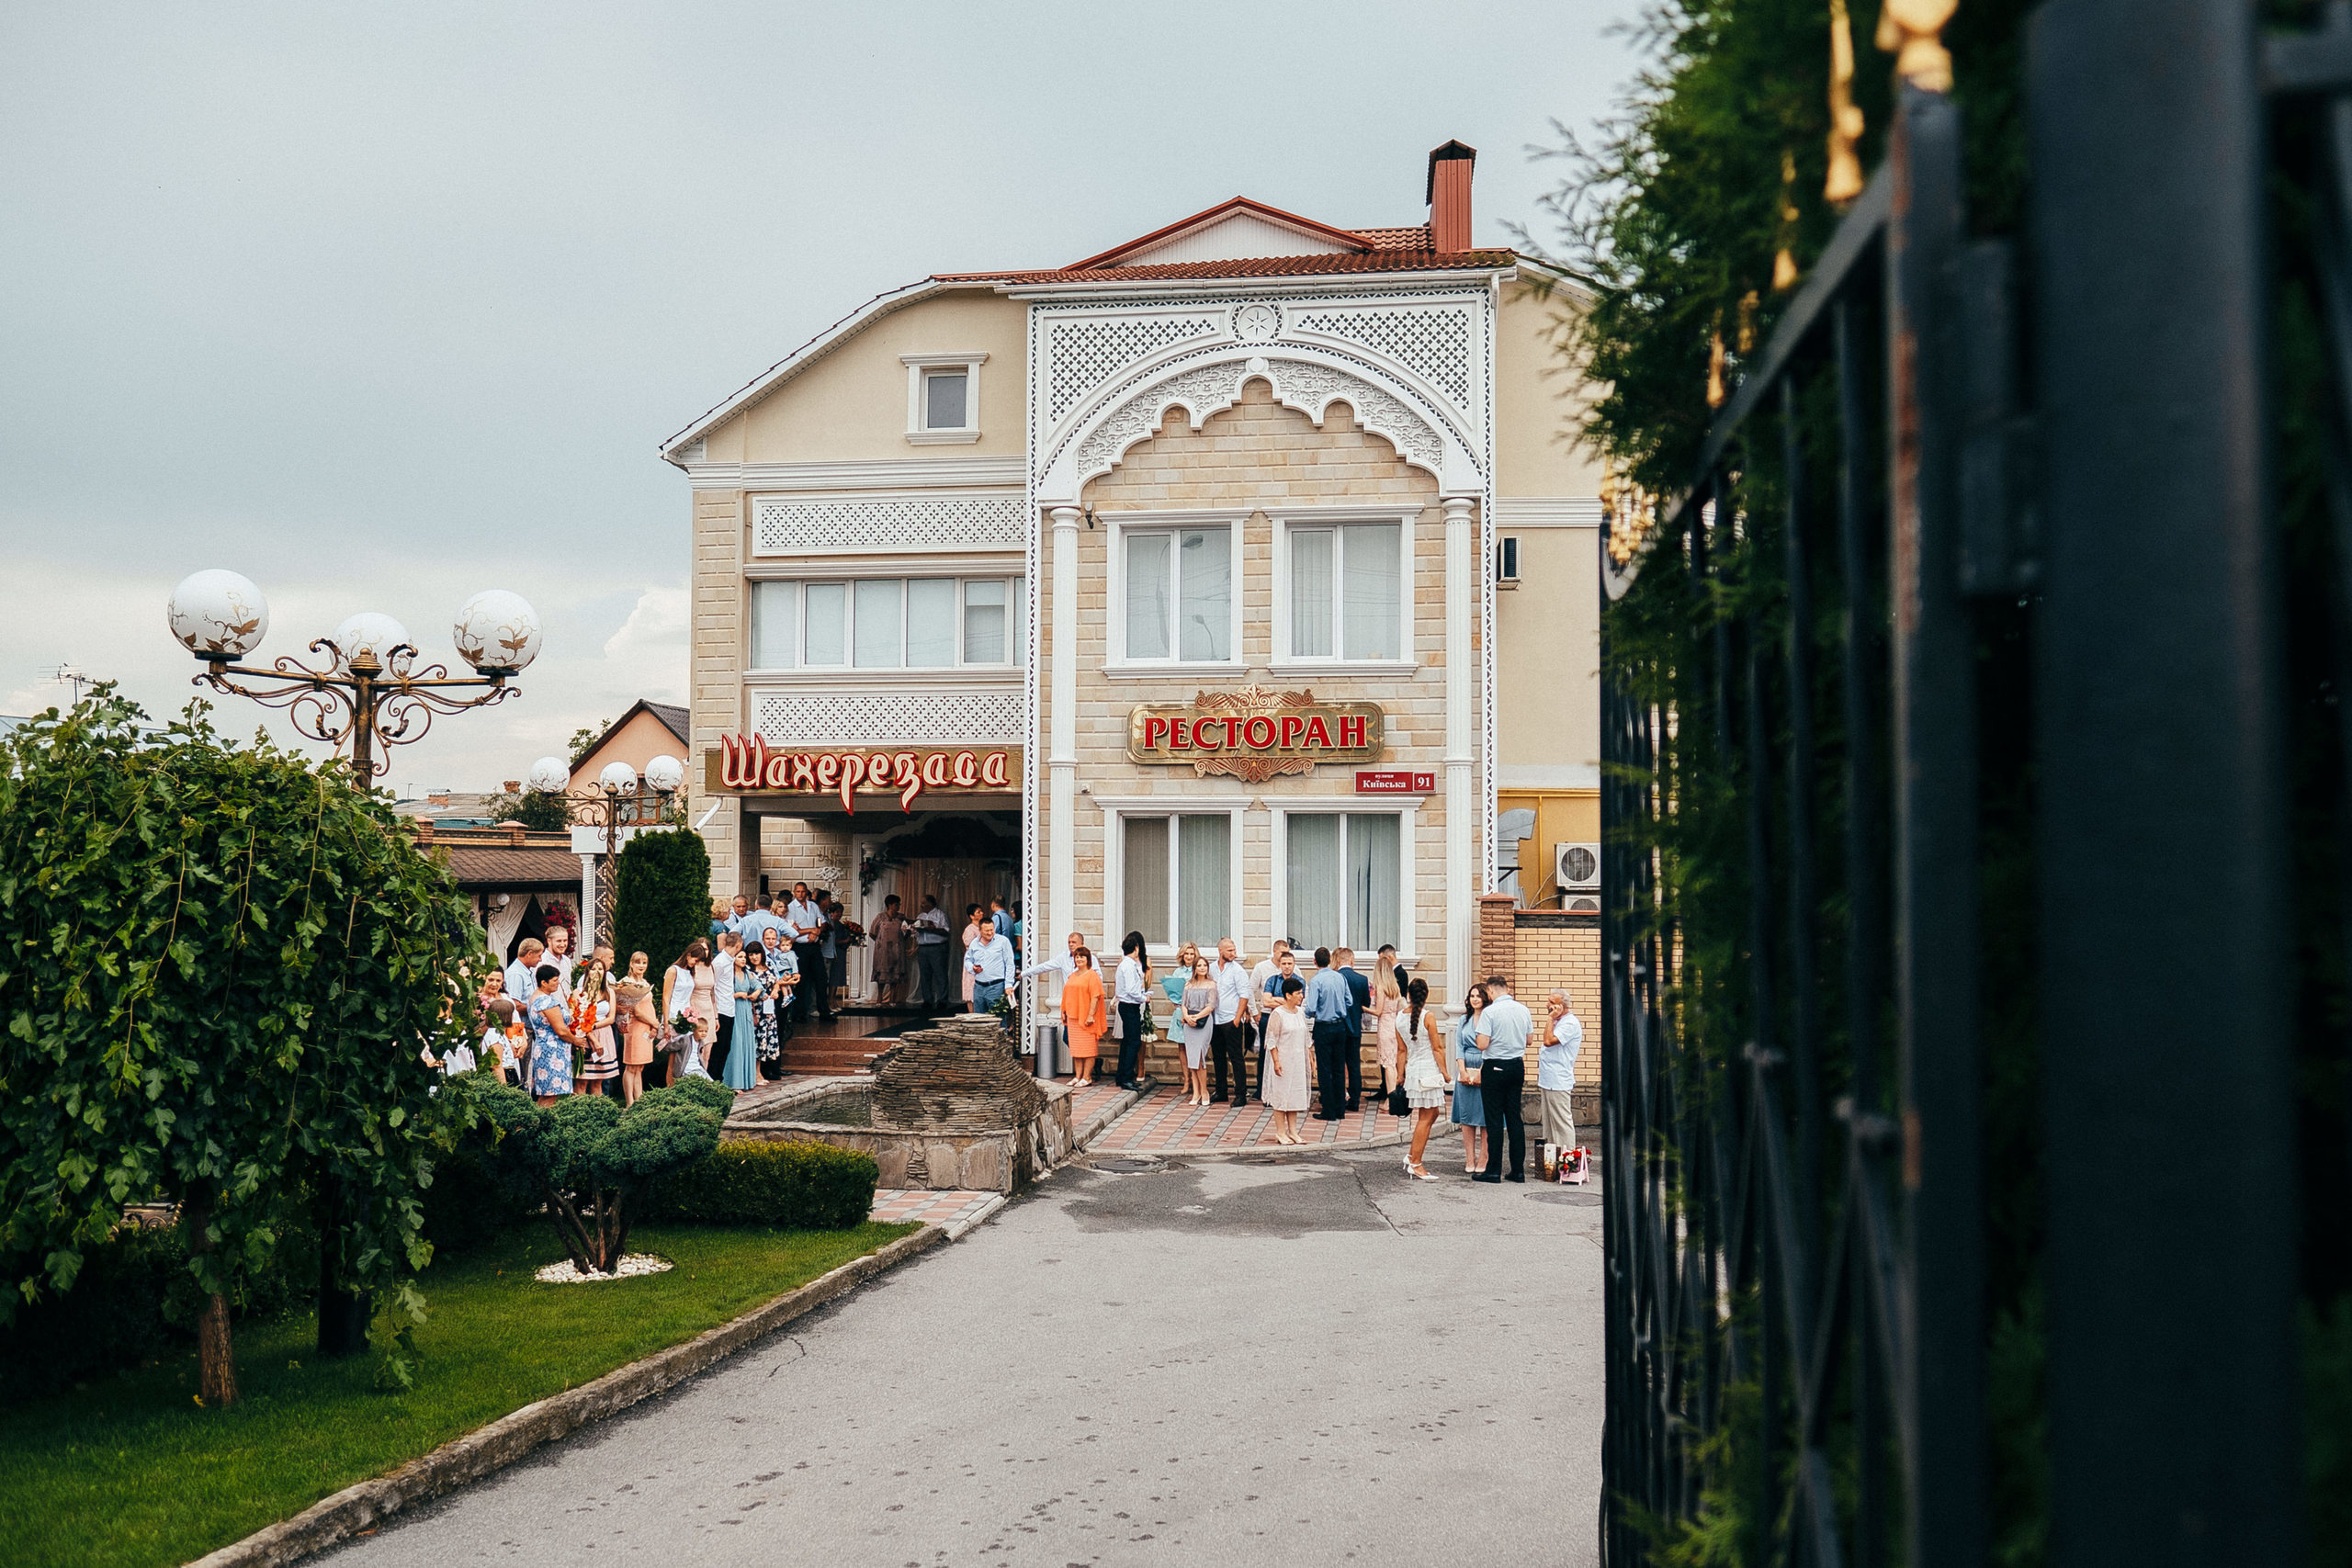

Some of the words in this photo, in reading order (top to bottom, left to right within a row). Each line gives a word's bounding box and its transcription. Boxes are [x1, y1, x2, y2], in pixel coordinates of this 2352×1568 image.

[1143, 716, 1369, 750] РЕСТОРАН
[720, 733, 1010, 815] Шахерезада
[1363, 780, 1407, 788] Київська
[1418, 777, 1430, 787] 91
